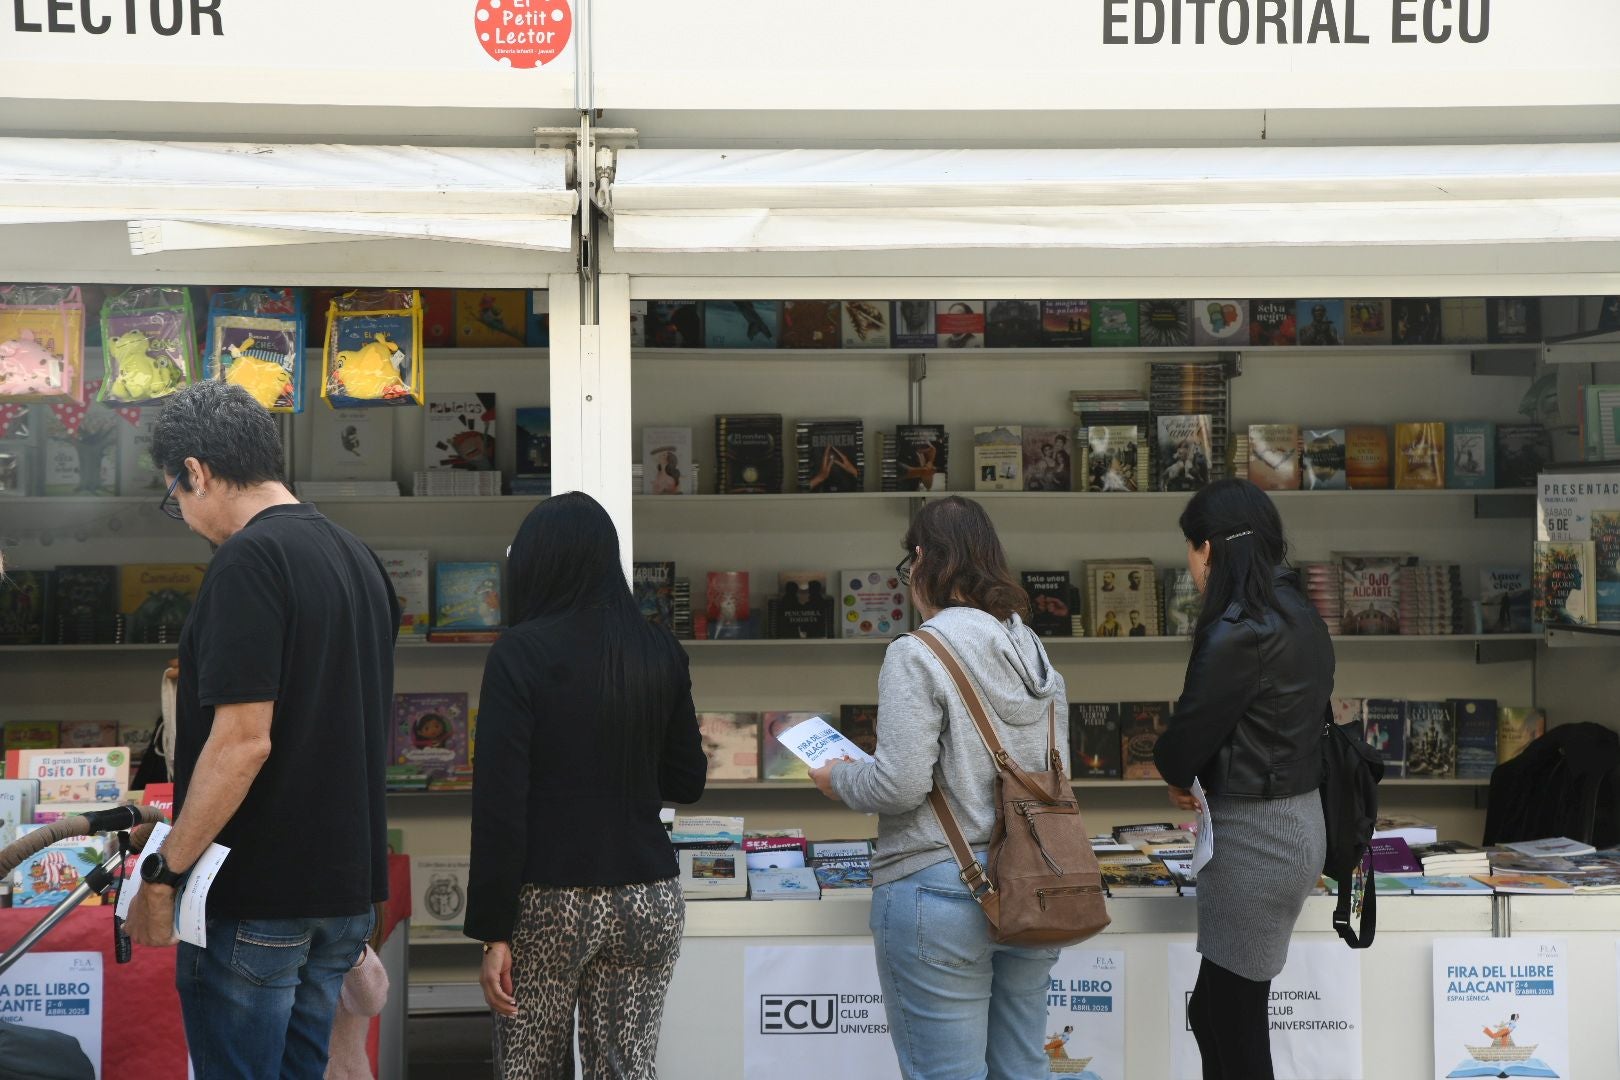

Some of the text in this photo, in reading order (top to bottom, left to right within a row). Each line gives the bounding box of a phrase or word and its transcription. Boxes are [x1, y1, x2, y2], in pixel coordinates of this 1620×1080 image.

[13, 0, 224, 37] LECTOR
[502, 10, 546, 26] Petit
[1102, 0, 1490, 45] EDITORIAL ECU
[495, 27, 555, 44] Lector
[1056, 307, 1088, 316] palabra
[1257, 304, 1286, 313] Selva
[1256, 313, 1287, 324] negra
[811, 434, 855, 448] BROKEN
[1548, 518, 1569, 531] 5 DE
[1027, 575, 1045, 583] Solo
[1368, 573, 1389, 586] OJO
[1489, 571, 1521, 582] Amor
[1353, 586, 1393, 597] ALICANTE
[1493, 582, 1522, 592] ciego
[797, 739, 813, 752] FIRA
[38, 764, 106, 777] Osito Tito
[1447, 965, 1554, 978] FIRA DEL LLIBRE
[15, 984, 41, 996] DEL
[45, 983, 90, 996] LIBRO
[1047, 980, 1112, 992] EL LIBRO
[1447, 981, 1514, 993] ALACANT
[840, 994, 883, 1004] EDITORI
[0, 999, 42, 1012] ANTE
[1267, 1006, 1293, 1016] CLUB
[765, 999, 834, 1029] ECU
[840, 1009, 868, 1019] CLUB
[840, 1024, 889, 1034] UNIVERSI
